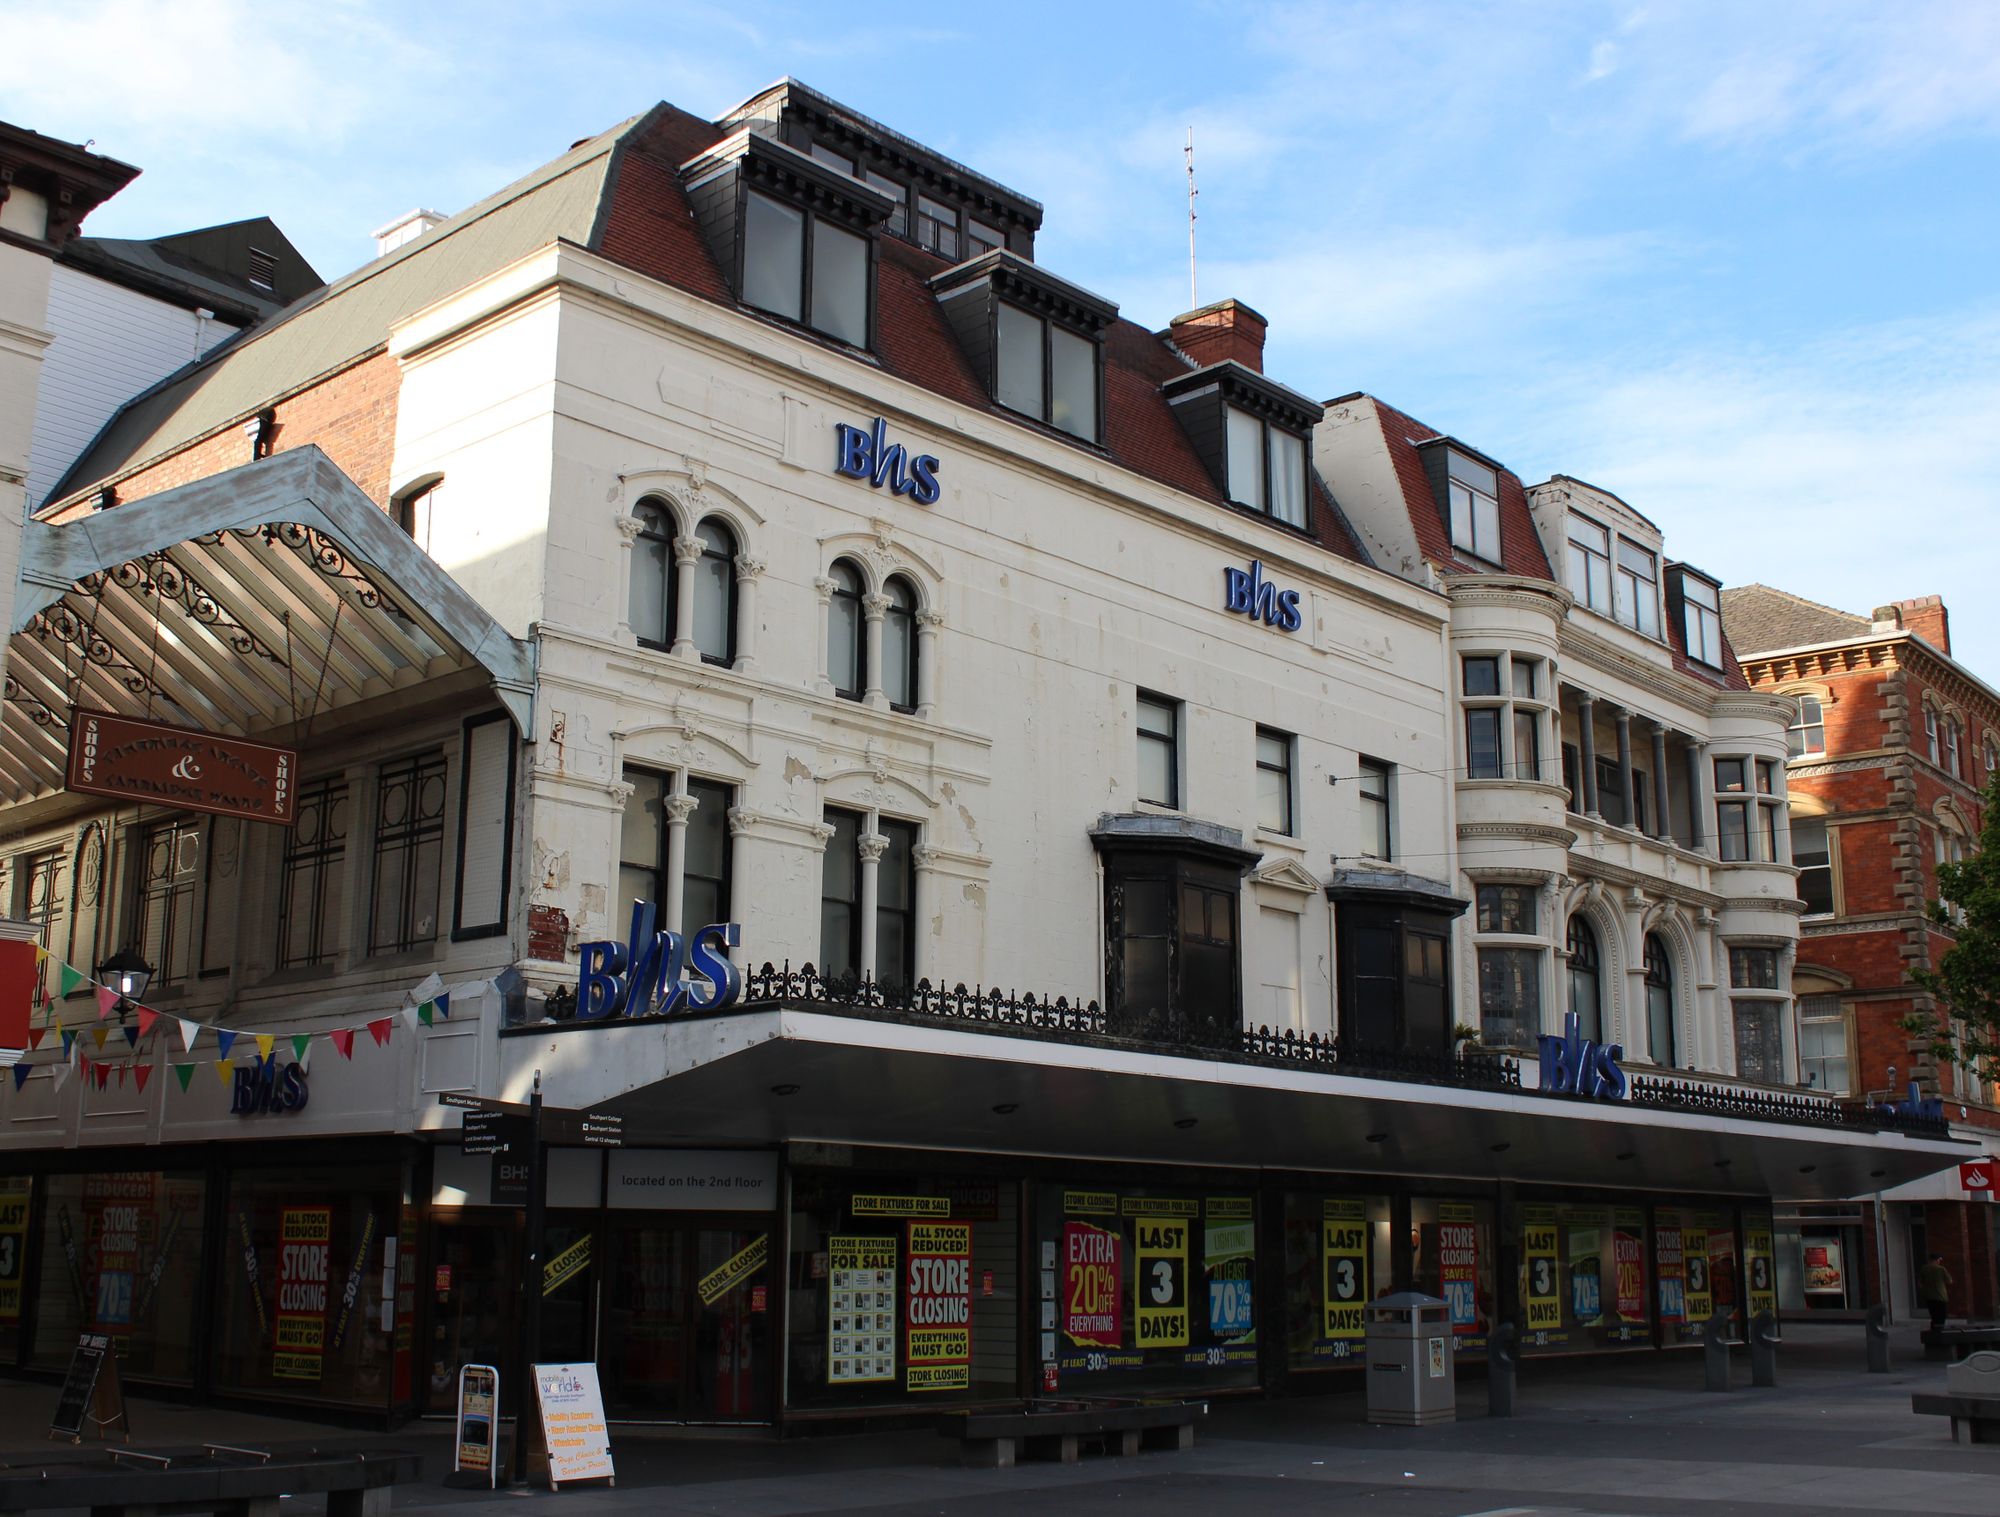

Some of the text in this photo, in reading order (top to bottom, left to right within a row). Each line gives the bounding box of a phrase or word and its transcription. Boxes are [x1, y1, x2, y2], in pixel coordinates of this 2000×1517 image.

[834, 416, 941, 505] Bhs
[1223, 559, 1301, 632] Bhs
[83, 719, 99, 783] SHOPS
[171, 754, 204, 781] &
[273, 754, 288, 815] SHOPS
[574, 896, 741, 1021] Bhs
[1535, 1011, 1626, 1101] Bhs
[230, 1051, 310, 1115] Bhs
[621, 1174, 763, 1189] located on the 2nd floor
[854, 1197, 949, 1211] STORE FIXTURES FOR SALE
[1065, 1193, 1085, 1205] STORE
[1123, 1200, 1198, 1211] STORE FIXTURES FOR SALE
[1207, 1200, 1224, 1210] STORE
[0, 1204, 25, 1225] AST
[103, 1207, 140, 1232] STORE
[285, 1212, 327, 1224] ALL STOCK
[284, 1225, 327, 1238] REDUCED!
[913, 1227, 967, 1239] ALL STOCK
[1139, 1226, 1184, 1249] LAST
[1327, 1228, 1364, 1249] LAST
[1440, 1226, 1475, 1248] STORE
[1656, 1231, 1681, 1251] STORE
[101, 1233, 137, 1252] CLOSING
[831, 1238, 895, 1248] STORE FIXTURES
[912, 1239, 968, 1252] REDUCED!
[1069, 1232, 1115, 1264] EXTRA
[1527, 1233, 1555, 1250] LAST
[1615, 1239, 1640, 1262] EXTRA
[1684, 1234, 1706, 1251] LAST
[281, 1244, 329, 1281] STORE
[831, 1254, 895, 1268] FOR SALE
[1441, 1249, 1475, 1266] CLOSING
[1657, 1250, 1682, 1265] CLOSING
[910, 1258, 969, 1295] STORE
[1223, 1261, 1248, 1281] LEAST
[1336, 1259, 1357, 1299] 3
[1444, 1269, 1465, 1279] SAVE
[1535, 1259, 1551, 1295] 3
[1690, 1259, 1703, 1291] 3
[1755, 1259, 1767, 1289] 3
[699, 1277, 729, 1298] STORE
[1070, 1263, 1115, 1315] 20%
[1151, 1260, 1174, 1304] 3
[1617, 1263, 1641, 1299] 20%
[280, 1283, 326, 1311] CLOSING
[1098, 1294, 1115, 1313] OFF
[1210, 1281, 1251, 1324] 70%
[1686, 1297, 1710, 1314] DAYS!
[910, 1296, 969, 1324] CLOSING
[1237, 1307, 1251, 1323] OFF
[1328, 1309, 1365, 1330] DAYS!
[1464, 1303, 1475, 1318] OFF
[1530, 1302, 1558, 1322] DAYS!
[279, 1319, 323, 1330] EVERYTHING
[1069, 1315, 1114, 1334] EVERYTHING
[1140, 1314, 1185, 1339] DAYS!
[279, 1331, 304, 1342] MUST
[911, 1332, 967, 1343] EVERYTHING
[911, 1342, 968, 1355] MUST GO!
[1192, 1353, 1206, 1363] LEAST
[1207, 1347, 1226, 1365] 30%
[1333, 1341, 1351, 1358] 30%
[274, 1356, 293, 1368] STORE
[1069, 1358, 1086, 1368] LEAST
[1087, 1353, 1108, 1370] 30%
[542, 1376, 573, 1393] world
[909, 1370, 967, 1382] STORE CLOSING!
[549, 1411, 594, 1422] Mobility Scooters
[553, 1438, 586, 1448] Wheelchairs
